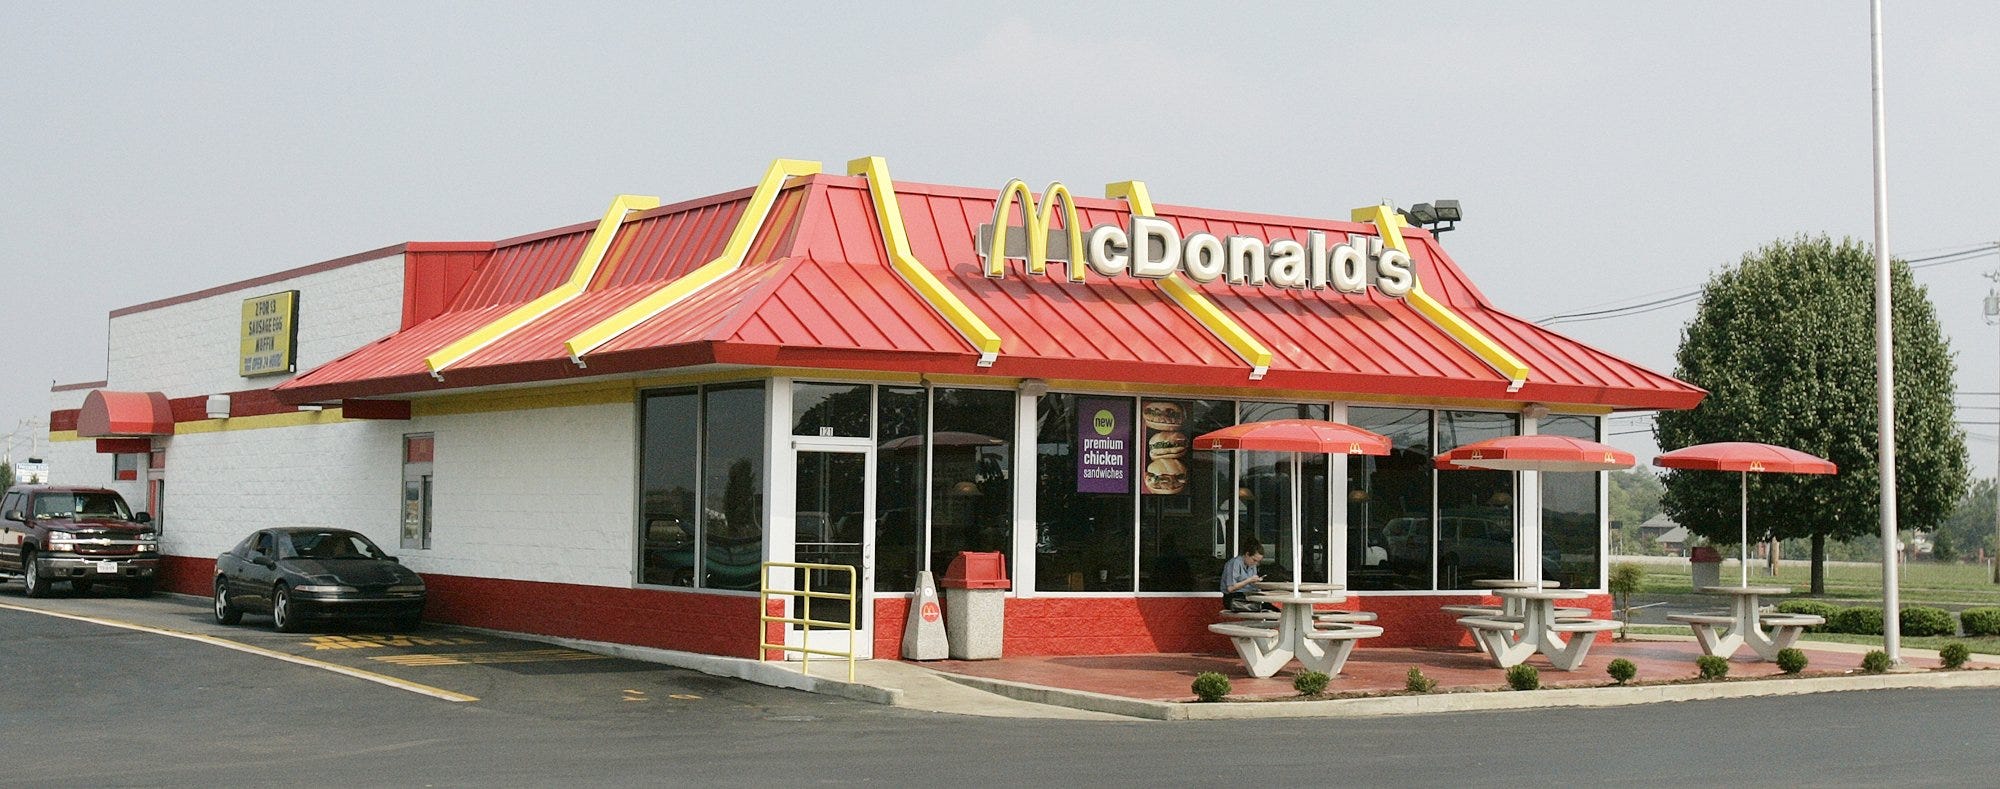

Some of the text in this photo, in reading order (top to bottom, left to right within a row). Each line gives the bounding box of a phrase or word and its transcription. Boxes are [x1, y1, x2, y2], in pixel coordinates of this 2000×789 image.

[986, 178, 1414, 297] McDonald's
[255, 302, 259, 317] 2
[259, 301, 269, 315] FOR
[248, 316, 283, 336] SAUSAGE EGG
[255, 336, 275, 352] MUFFIN
[1095, 417, 1114, 428] new
[1084, 437, 1124, 451] premium
[1084, 451, 1123, 466] chicken
[1083, 467, 1124, 479] sandwiches
